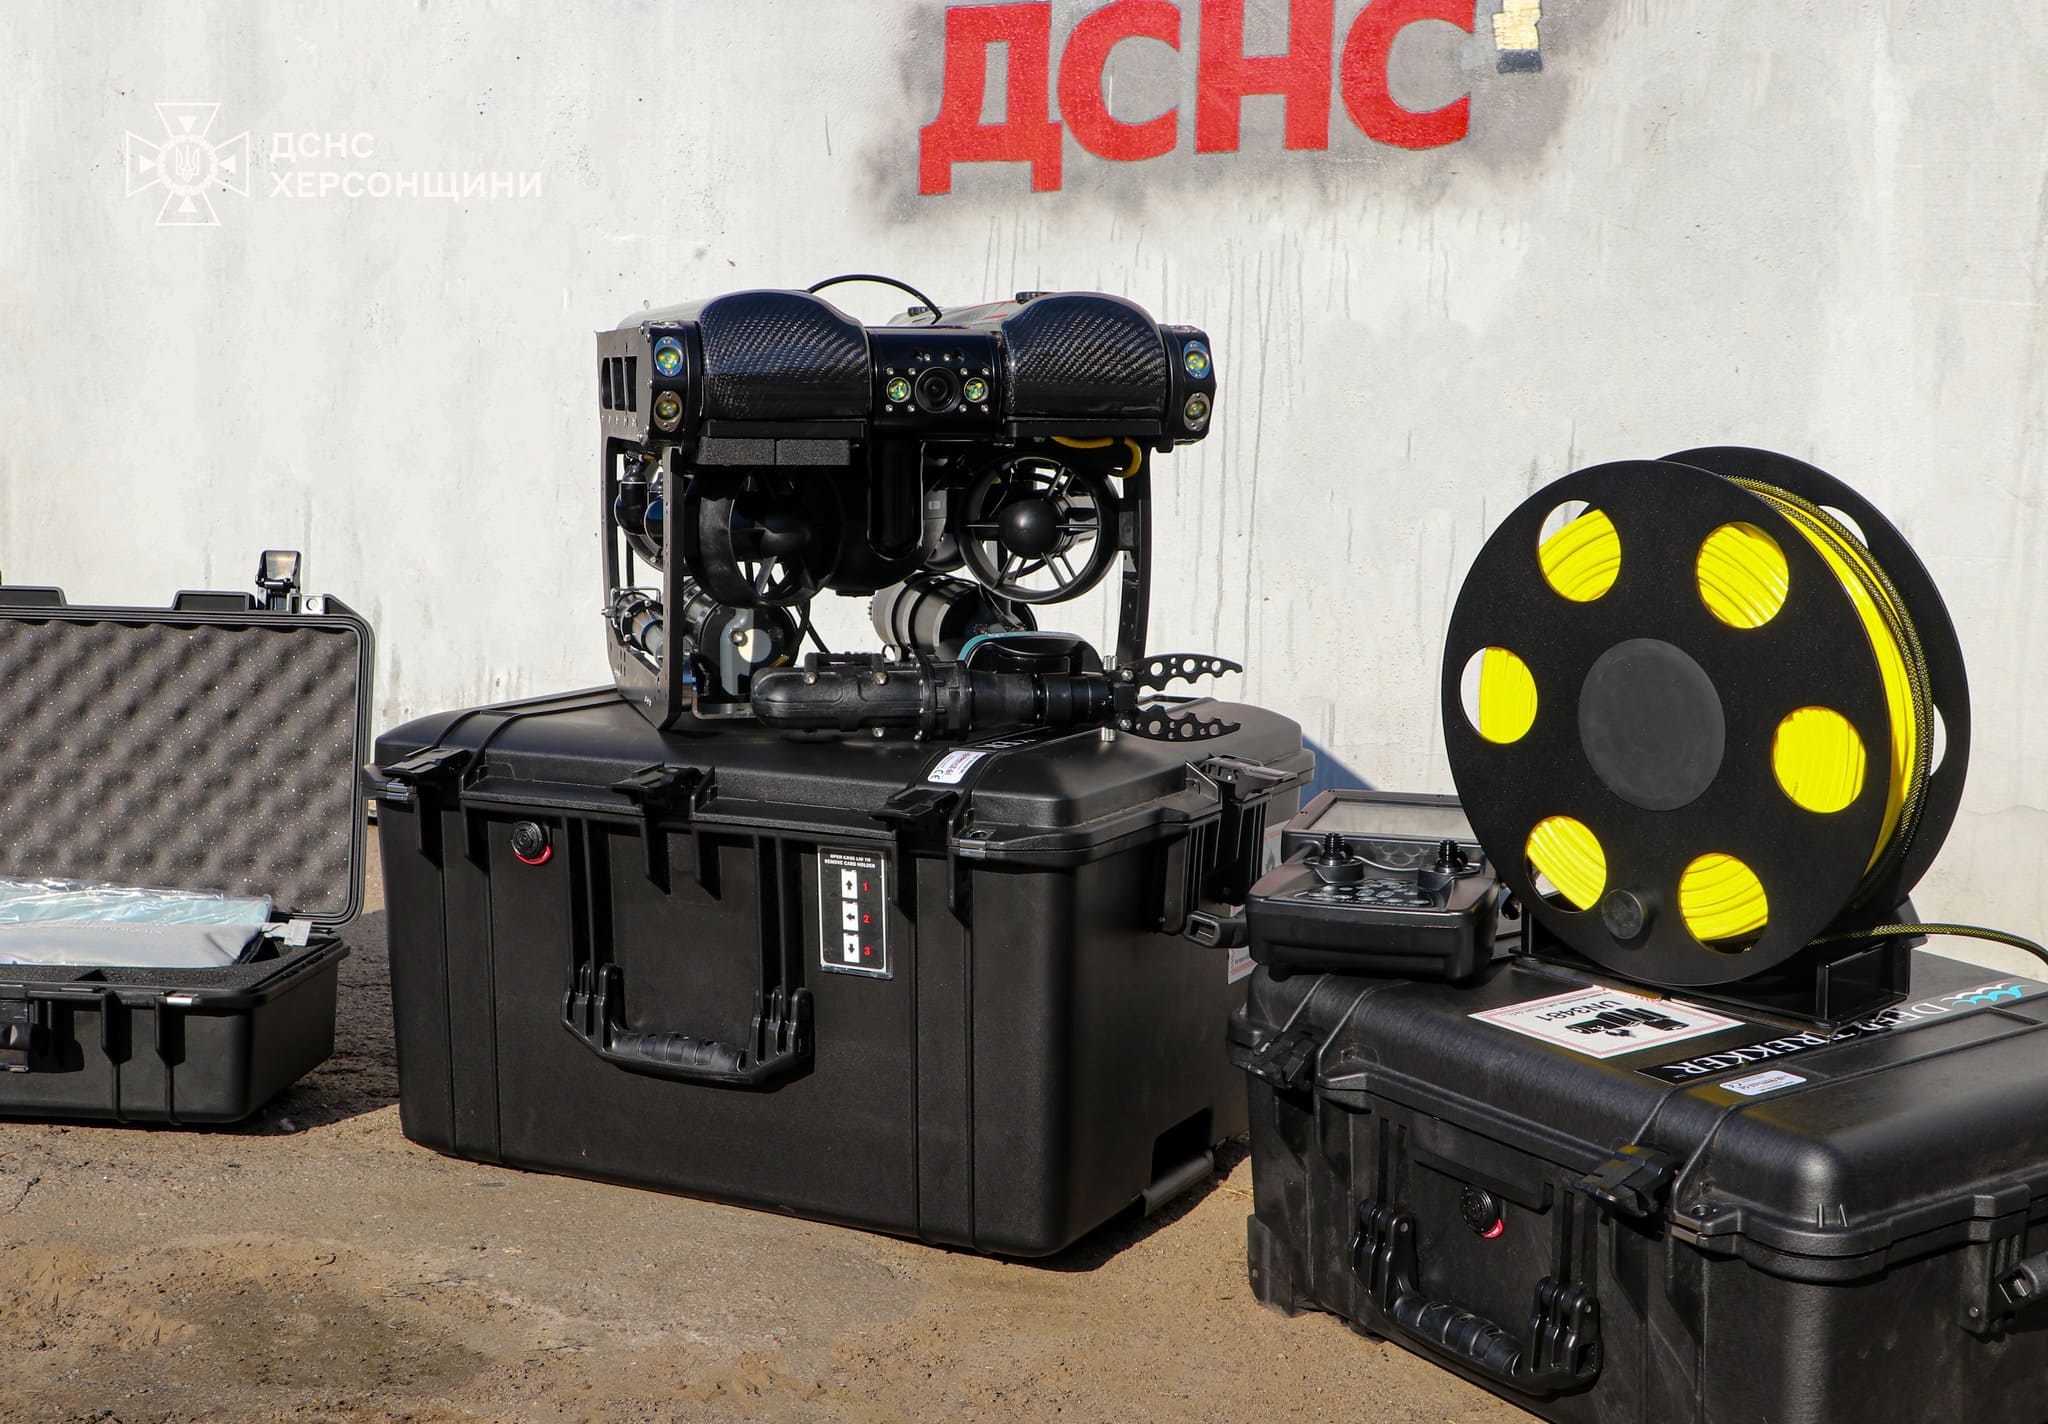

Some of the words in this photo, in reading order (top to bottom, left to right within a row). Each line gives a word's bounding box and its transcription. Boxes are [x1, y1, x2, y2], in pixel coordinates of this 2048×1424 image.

[919, 0, 1475, 194] ДСНС
[863, 882, 869, 891] 1
[863, 915, 870, 923] 2
[864, 947, 871, 955] 3
[1536, 1000, 1623, 1022] UN3481
